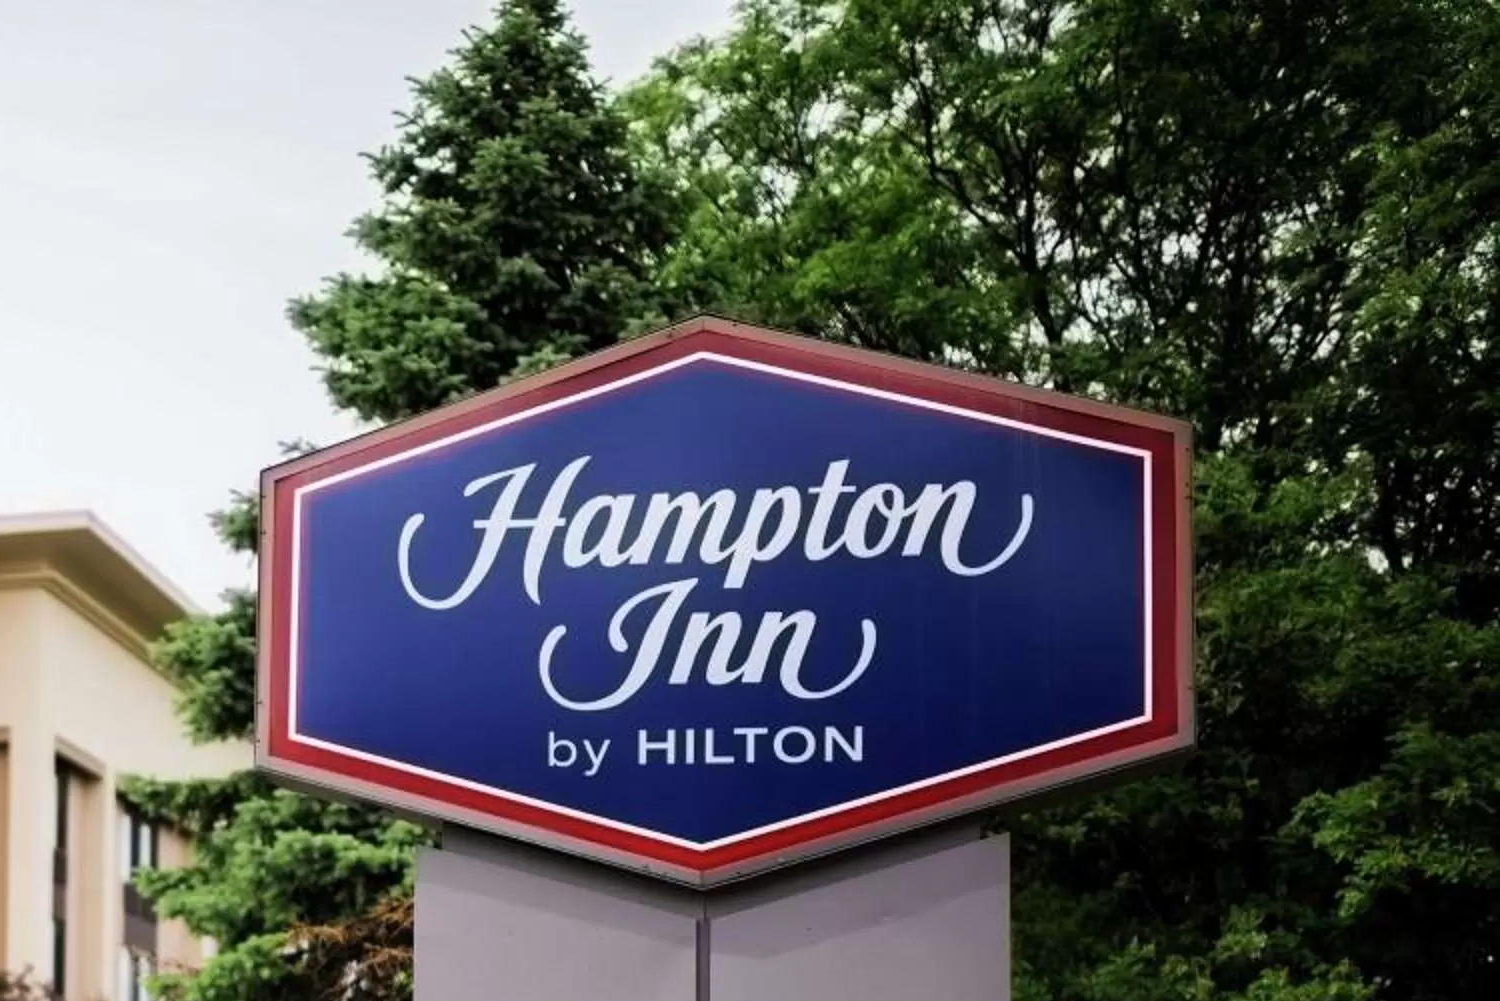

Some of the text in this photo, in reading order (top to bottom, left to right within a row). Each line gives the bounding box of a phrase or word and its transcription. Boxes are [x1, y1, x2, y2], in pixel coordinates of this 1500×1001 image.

[397, 455, 1034, 610] Hampton
[538, 577, 877, 711] Inn
[548, 726, 863, 777] by HILTON
